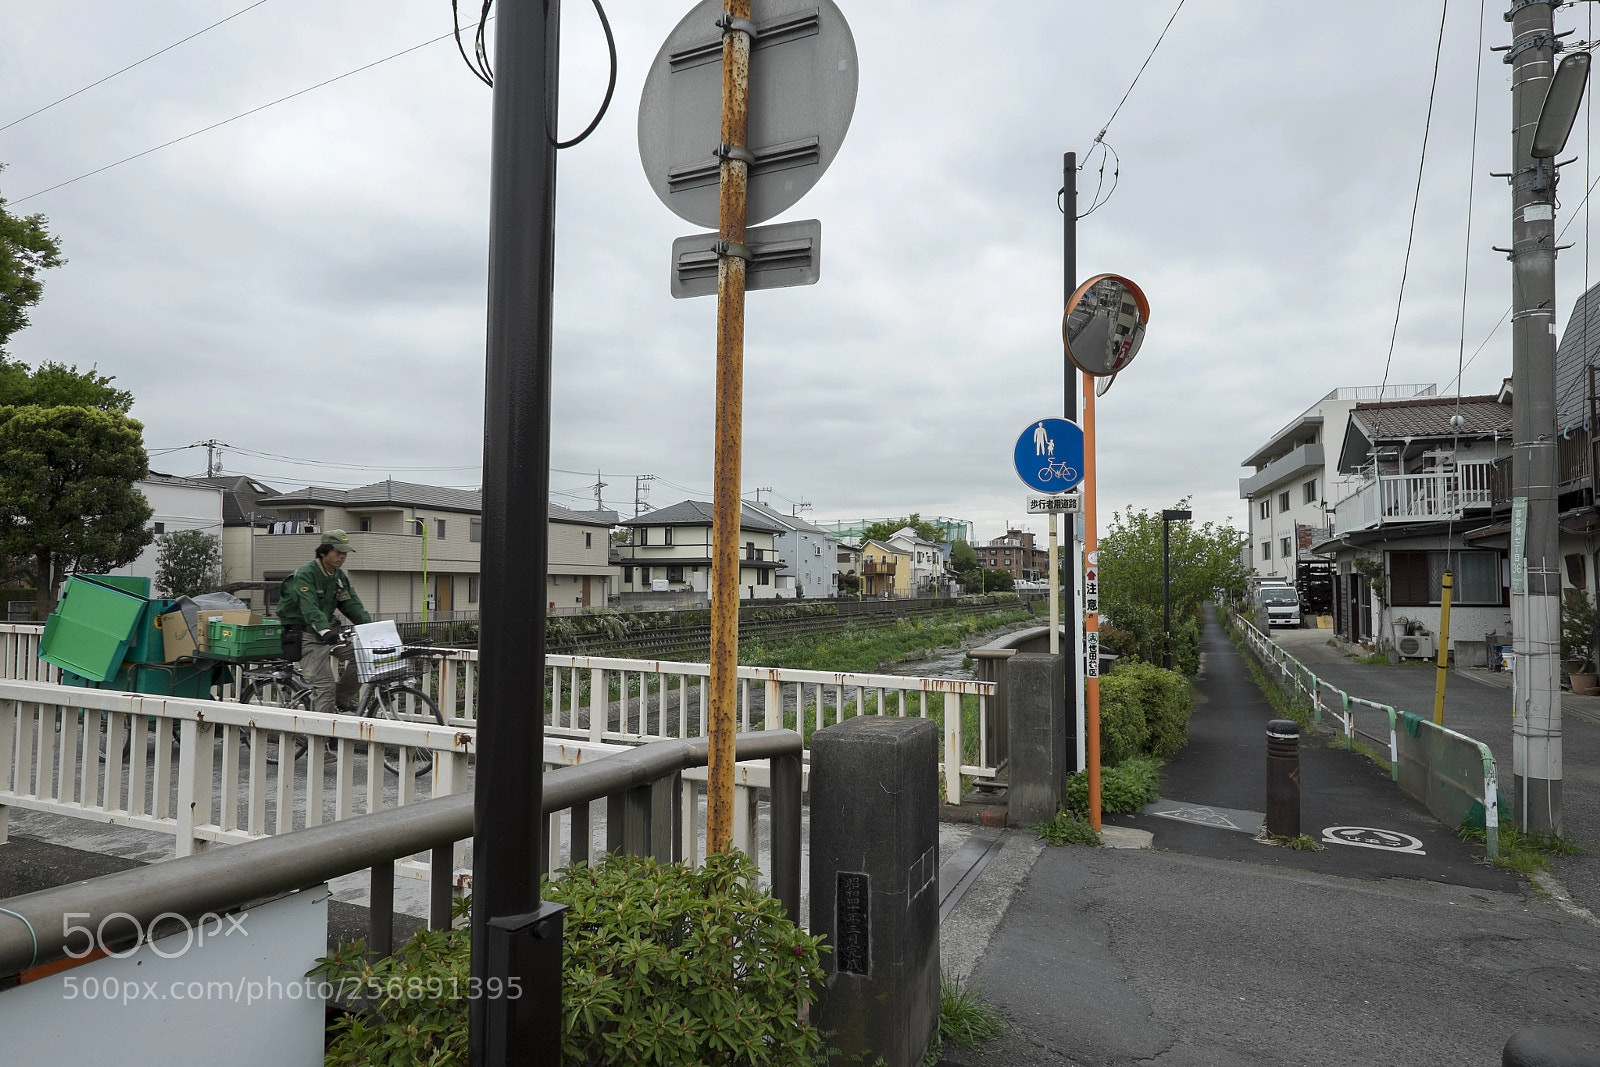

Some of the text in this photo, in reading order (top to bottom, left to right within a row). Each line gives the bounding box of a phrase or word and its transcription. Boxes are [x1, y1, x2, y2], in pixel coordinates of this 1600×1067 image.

[1030, 499, 1077, 510] 歩行者用道路
[1514, 509, 1523, 562] 喜多見七丁目
[1512, 563, 1522, 574] 36
[1086, 583, 1098, 611] 注意
